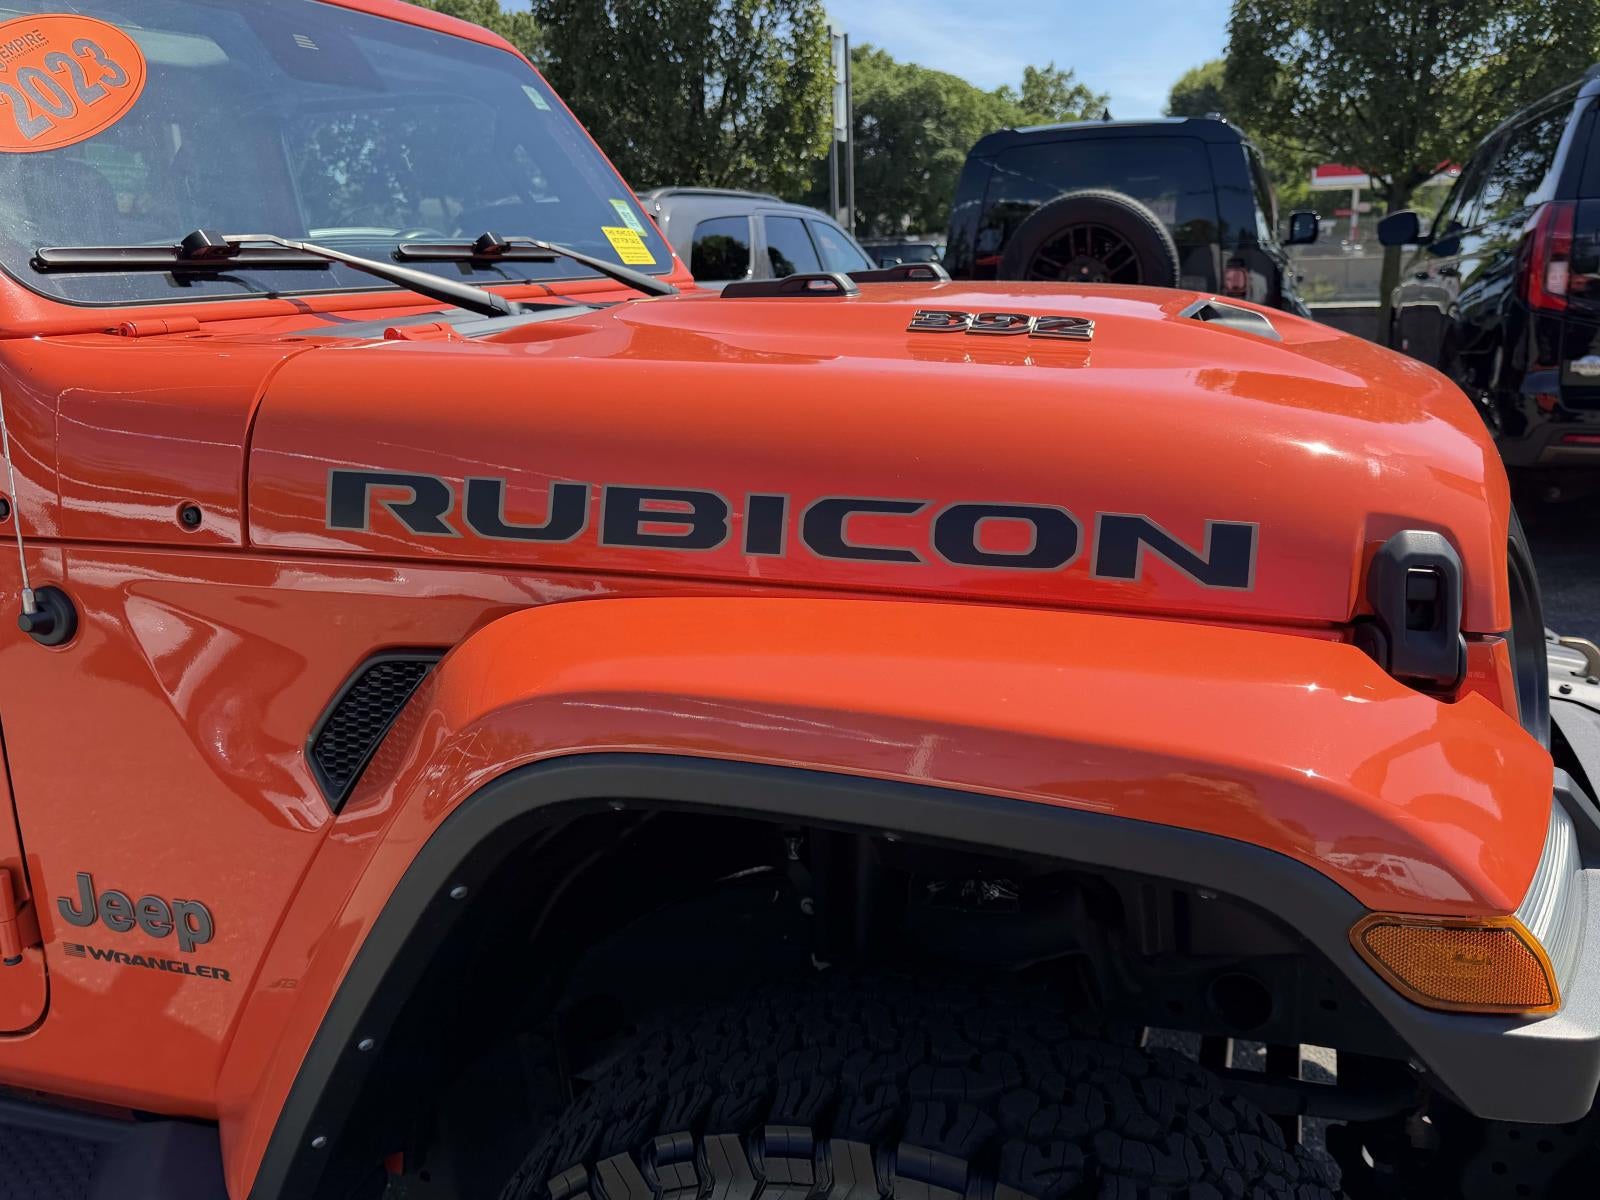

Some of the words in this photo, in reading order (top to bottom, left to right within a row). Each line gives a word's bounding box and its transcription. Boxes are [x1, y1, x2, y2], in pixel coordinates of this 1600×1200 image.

[0, 29, 46, 59] EMPIRE
[0, 38, 131, 142] 2023
[906, 309, 1095, 341] 392
[326, 468, 1260, 592] RUBICON
[57, 872, 216, 953] Jeep
[86, 945, 232, 982] WRANGLER
